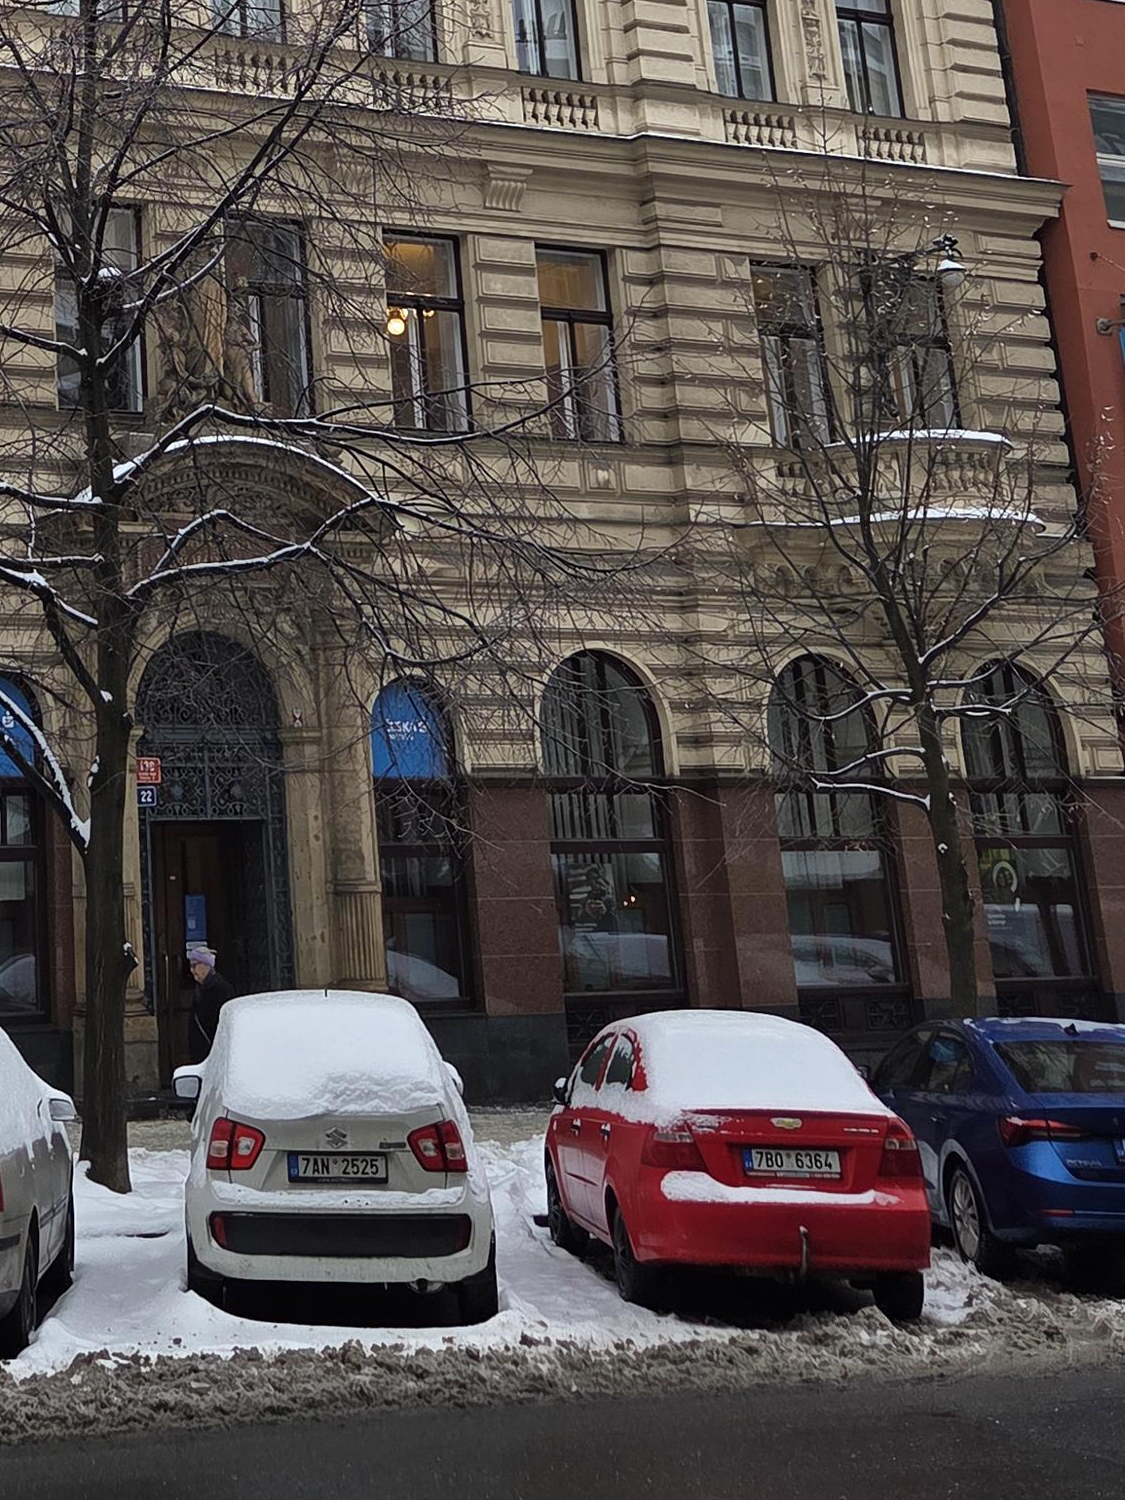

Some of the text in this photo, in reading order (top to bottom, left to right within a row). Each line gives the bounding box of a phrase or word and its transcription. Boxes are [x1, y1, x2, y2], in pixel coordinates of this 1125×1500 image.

[140, 790, 153, 803] 22
[302, 1157, 379, 1176] 7AN 2525
[795, 1152, 833, 1170] 6364
